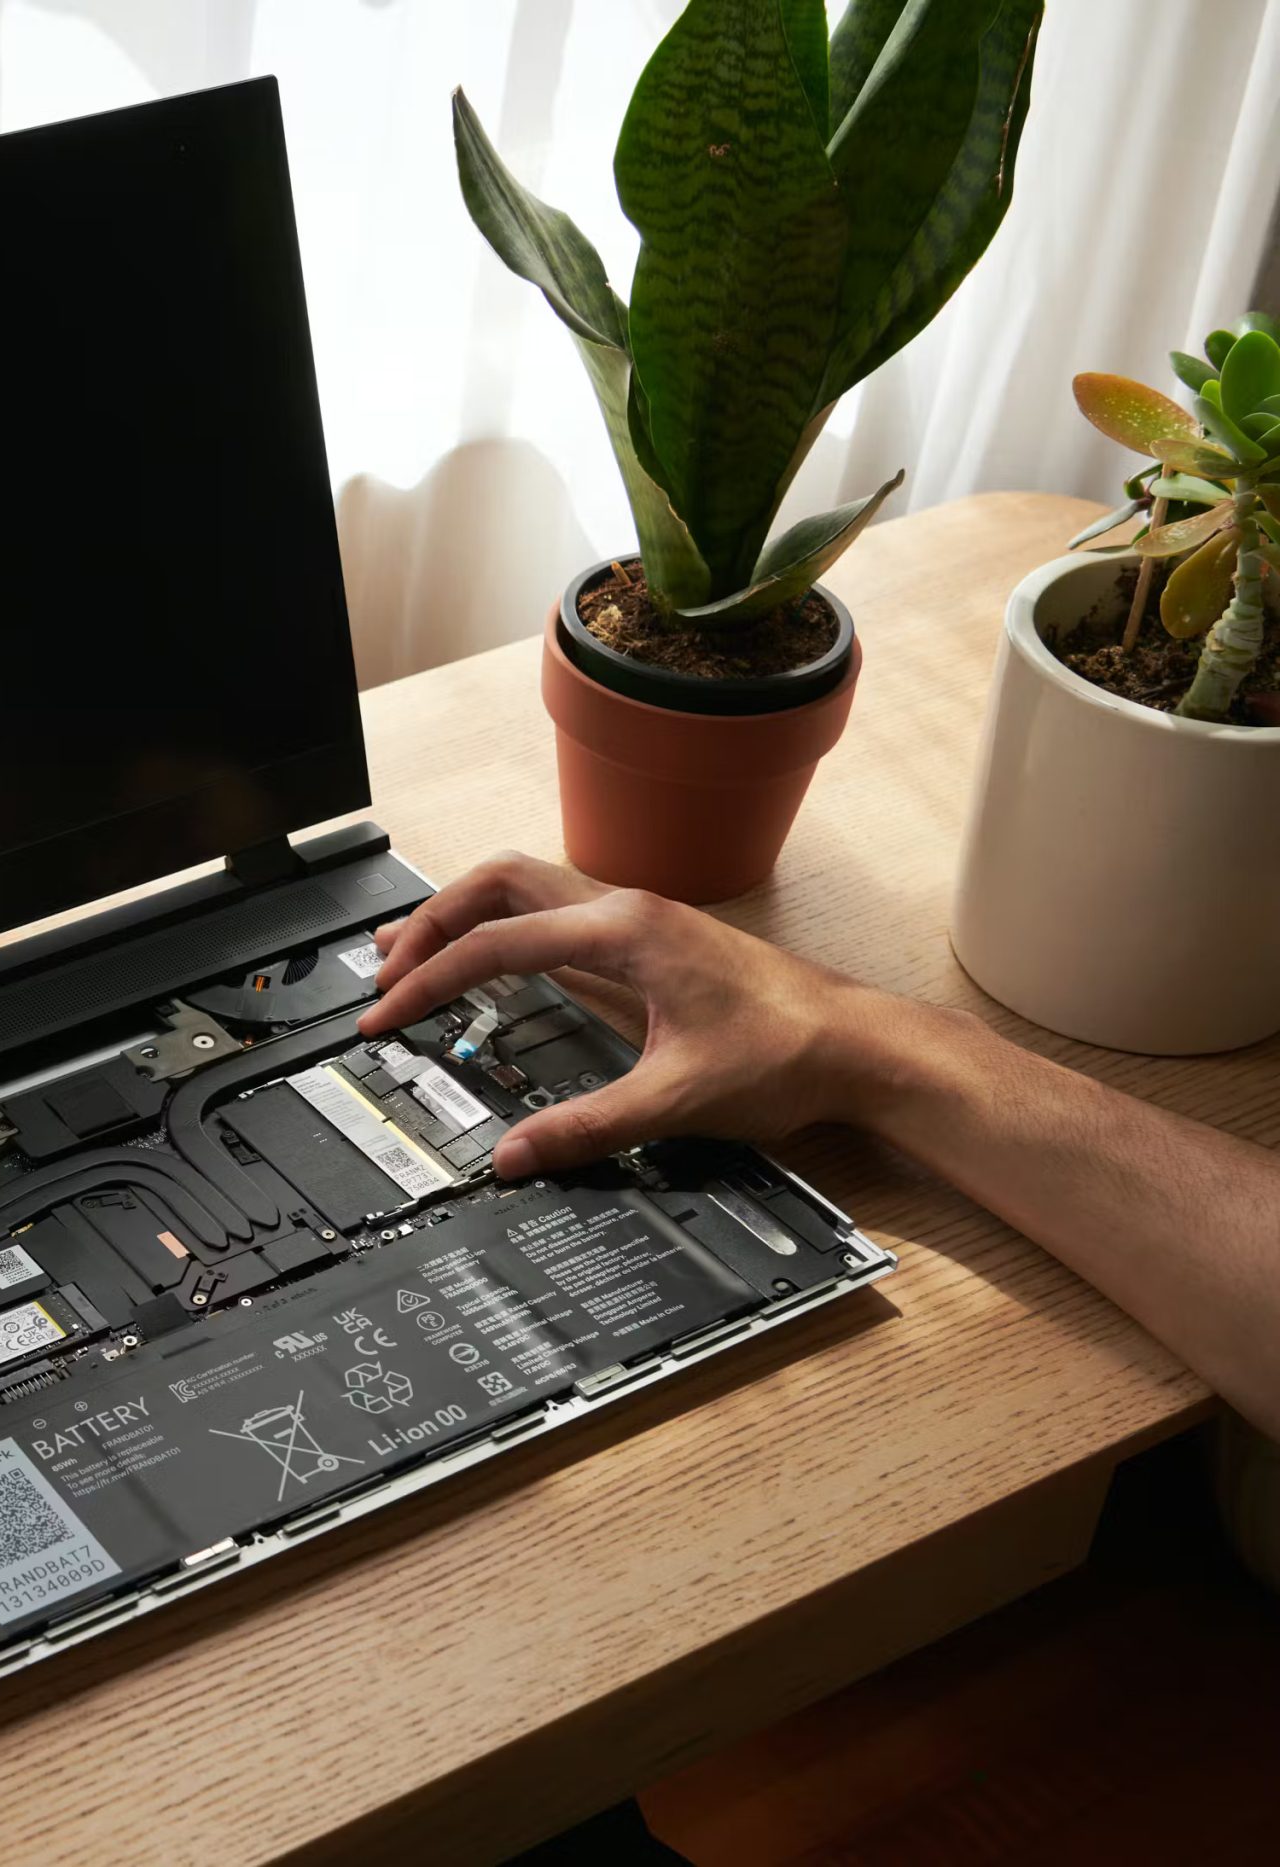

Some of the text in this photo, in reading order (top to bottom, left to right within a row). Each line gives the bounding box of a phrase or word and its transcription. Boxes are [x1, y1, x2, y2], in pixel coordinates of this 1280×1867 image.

[538, 1206, 572, 1223] Caution
[536, 1246, 549, 1254] not
[547, 1231, 589, 1249] disassemble,
[588, 1218, 619, 1233] puncture,
[618, 1209, 638, 1219] crush,
[531, 1255, 548, 1264] heat
[553, 1245, 571, 1254] burn
[580, 1231, 607, 1243] battery.
[550, 1269, 572, 1280] Please
[595, 1248, 620, 1261] charger
[620, 1235, 650, 1251] specified
[422, 1249, 486, 1278] Rechargeable Li-ion
[427, 1259, 480, 1284] Polymer Battery
[573, 1280, 586, 1288] pas
[622, 1252, 652, 1267] pénétrer,
[577, 1263, 602, 1277] original
[600, 1255, 626, 1267] factory.
[595, 1272, 622, 1286] déchirer
[629, 1260, 650, 1271] brûler
[655, 1246, 684, 1259] batterie.
[453, 1276, 475, 1288] Model
[601, 1279, 644, 1300] Manufacturer
[456, 1286, 510, 1311] Typical Capacity
[509, 1302, 528, 1312] Rated
[527, 1291, 557, 1305] Capacity
[593, 1291, 656, 1320] Dongguan Amperex
[599, 1296, 662, 1326] Technology Limited
[520, 1318, 548, 1333] Nominal
[546, 1309, 573, 1322] Voltage
[638, 1316, 658, 1325] Made
[664, 1304, 685, 1315] China
[423, 1323, 461, 1342] FRAMEWORK
[431, 1329, 464, 1345] COMPUTER
[516, 1331, 599, 1370] Limited Charging Voltage
[196, 1362, 233, 1379] Certification
[32, 1396, 150, 1460] BATTERY
[367, 1404, 468, 1455] Li-ion 00
[51, 1458, 78, 1472] 85Wh
[60, 1472, 79, 1482] This
[78, 1459, 108, 1475] battery
[117, 1435, 164, 1457] replaceable
[66, 1482, 78, 1490] To
[78, 1476, 94, 1485] see
[94, 1466, 117, 1479] more
